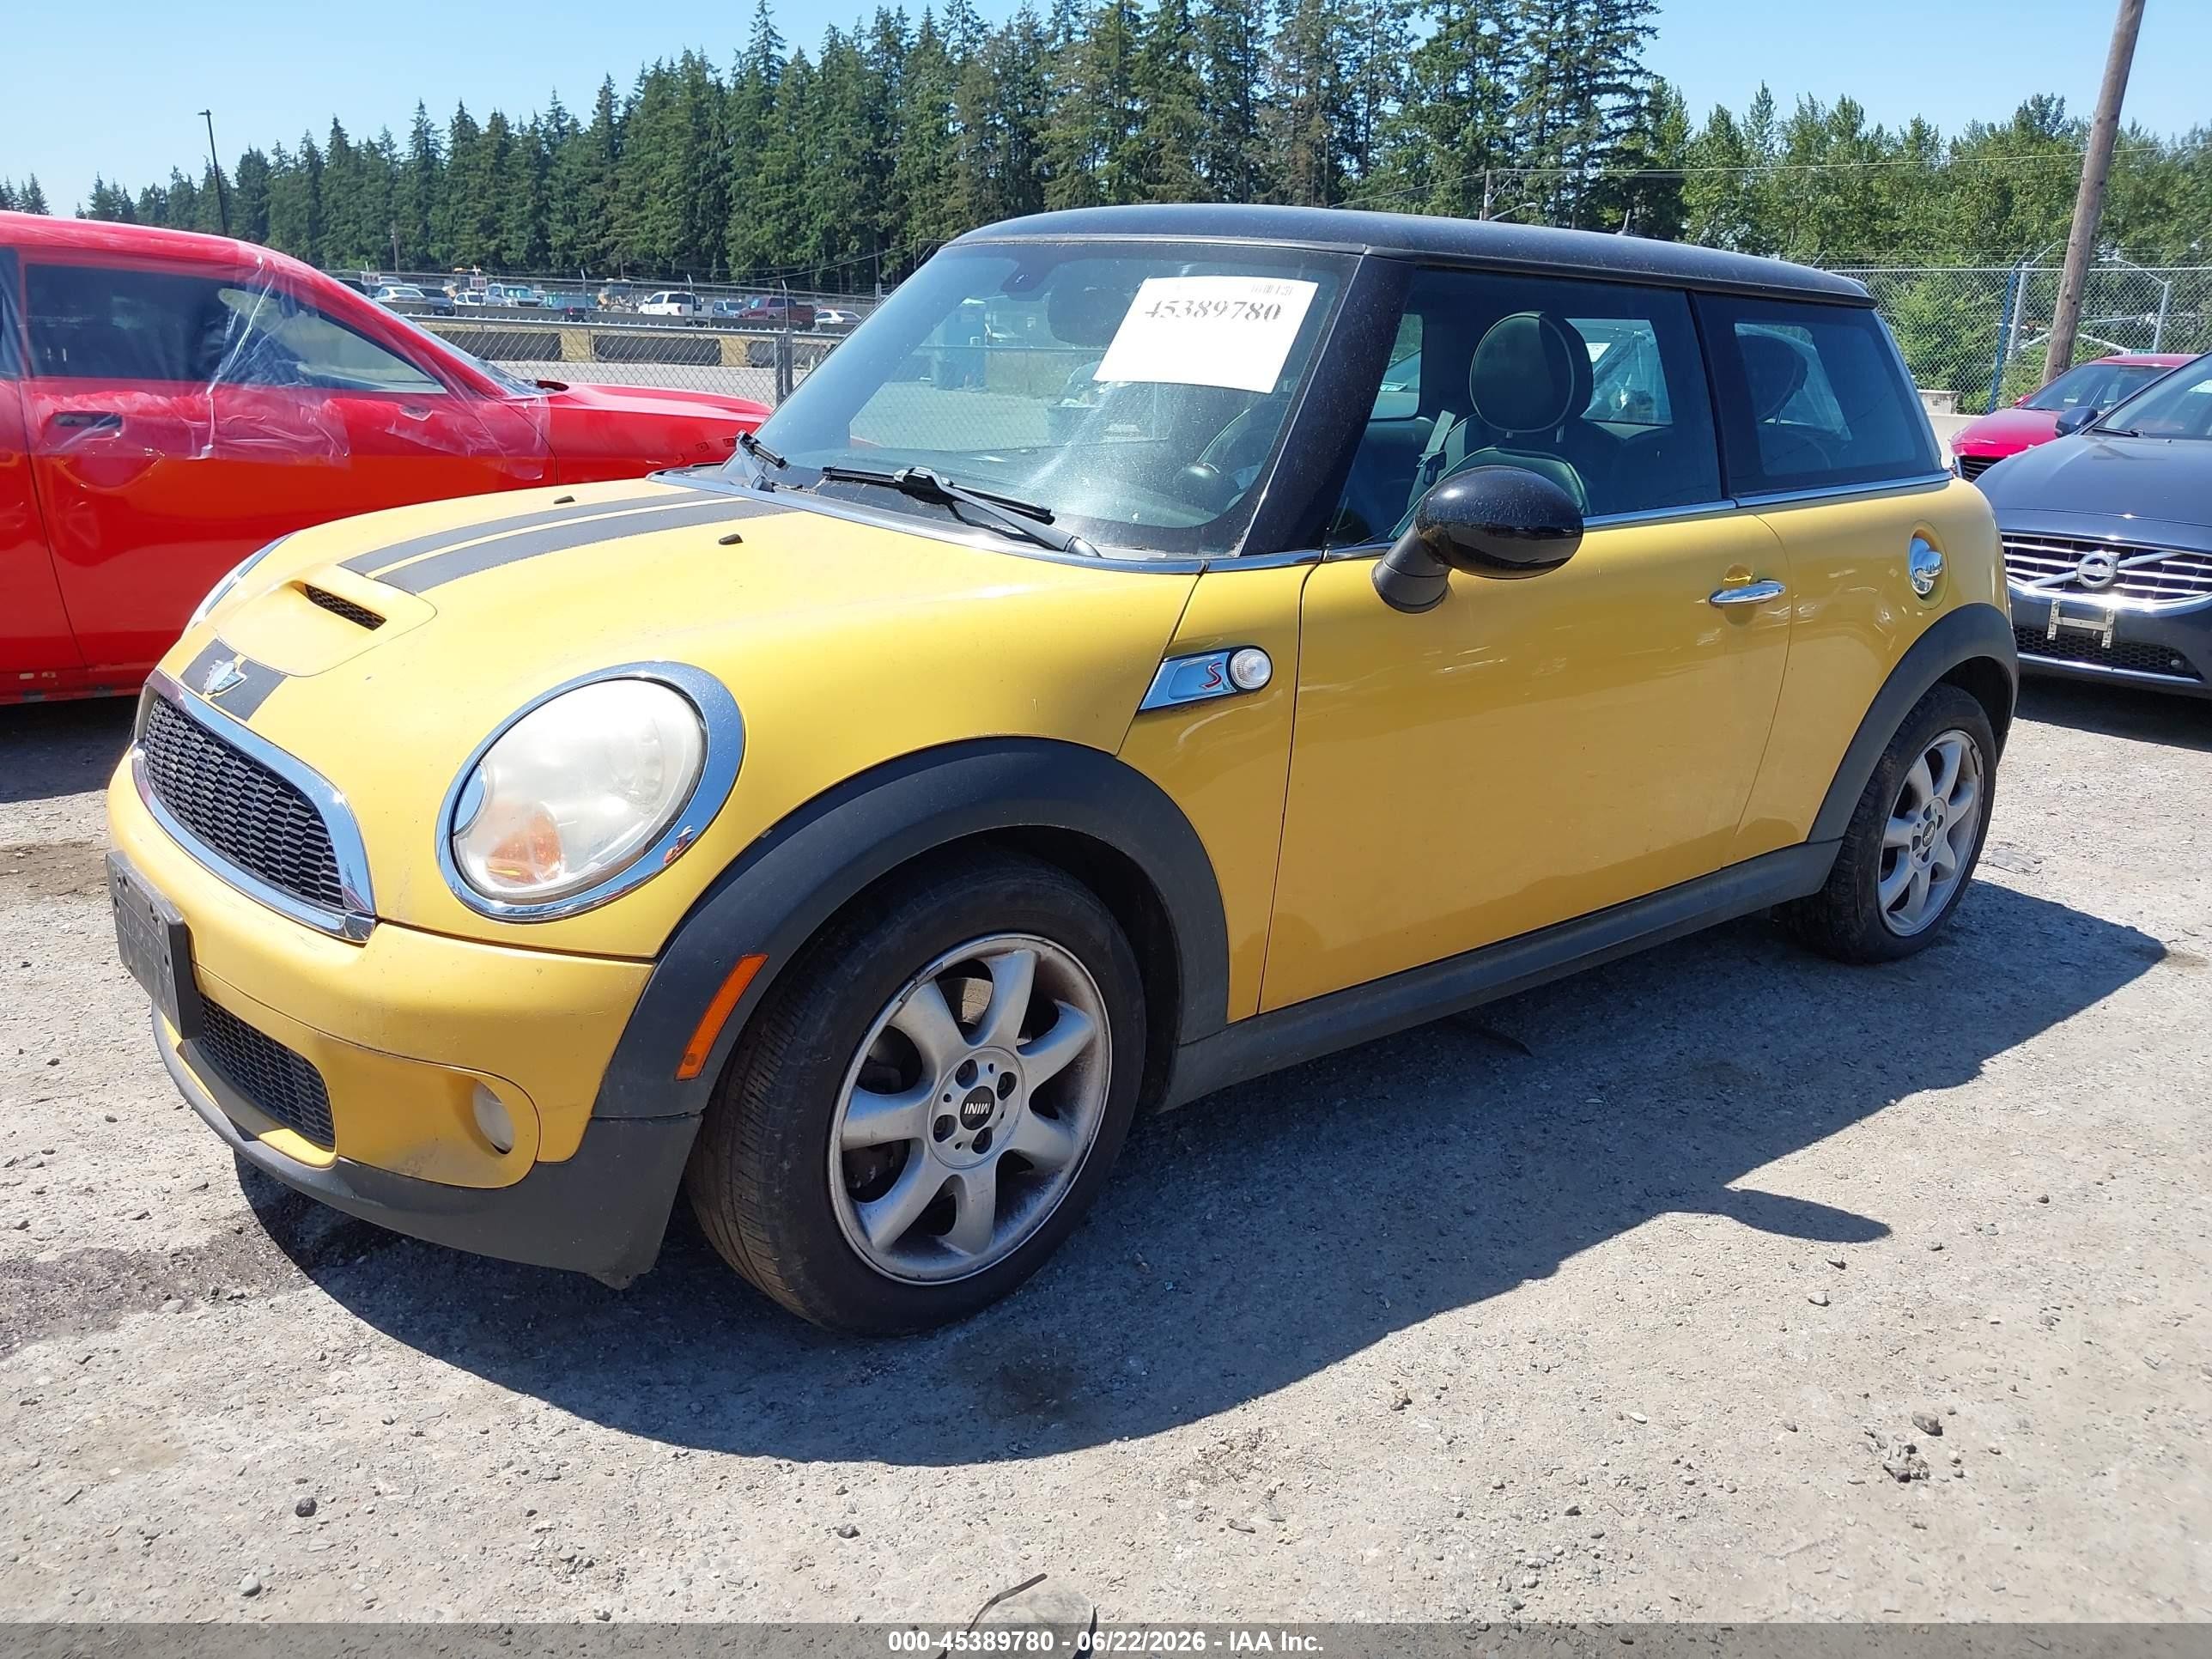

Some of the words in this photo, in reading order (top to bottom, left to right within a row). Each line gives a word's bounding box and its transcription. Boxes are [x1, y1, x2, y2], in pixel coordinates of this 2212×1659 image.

[1145, 300, 1282, 322] 45389780
[1202, 661, 1224, 690] S
[963, 1103, 991, 1115] MINI
